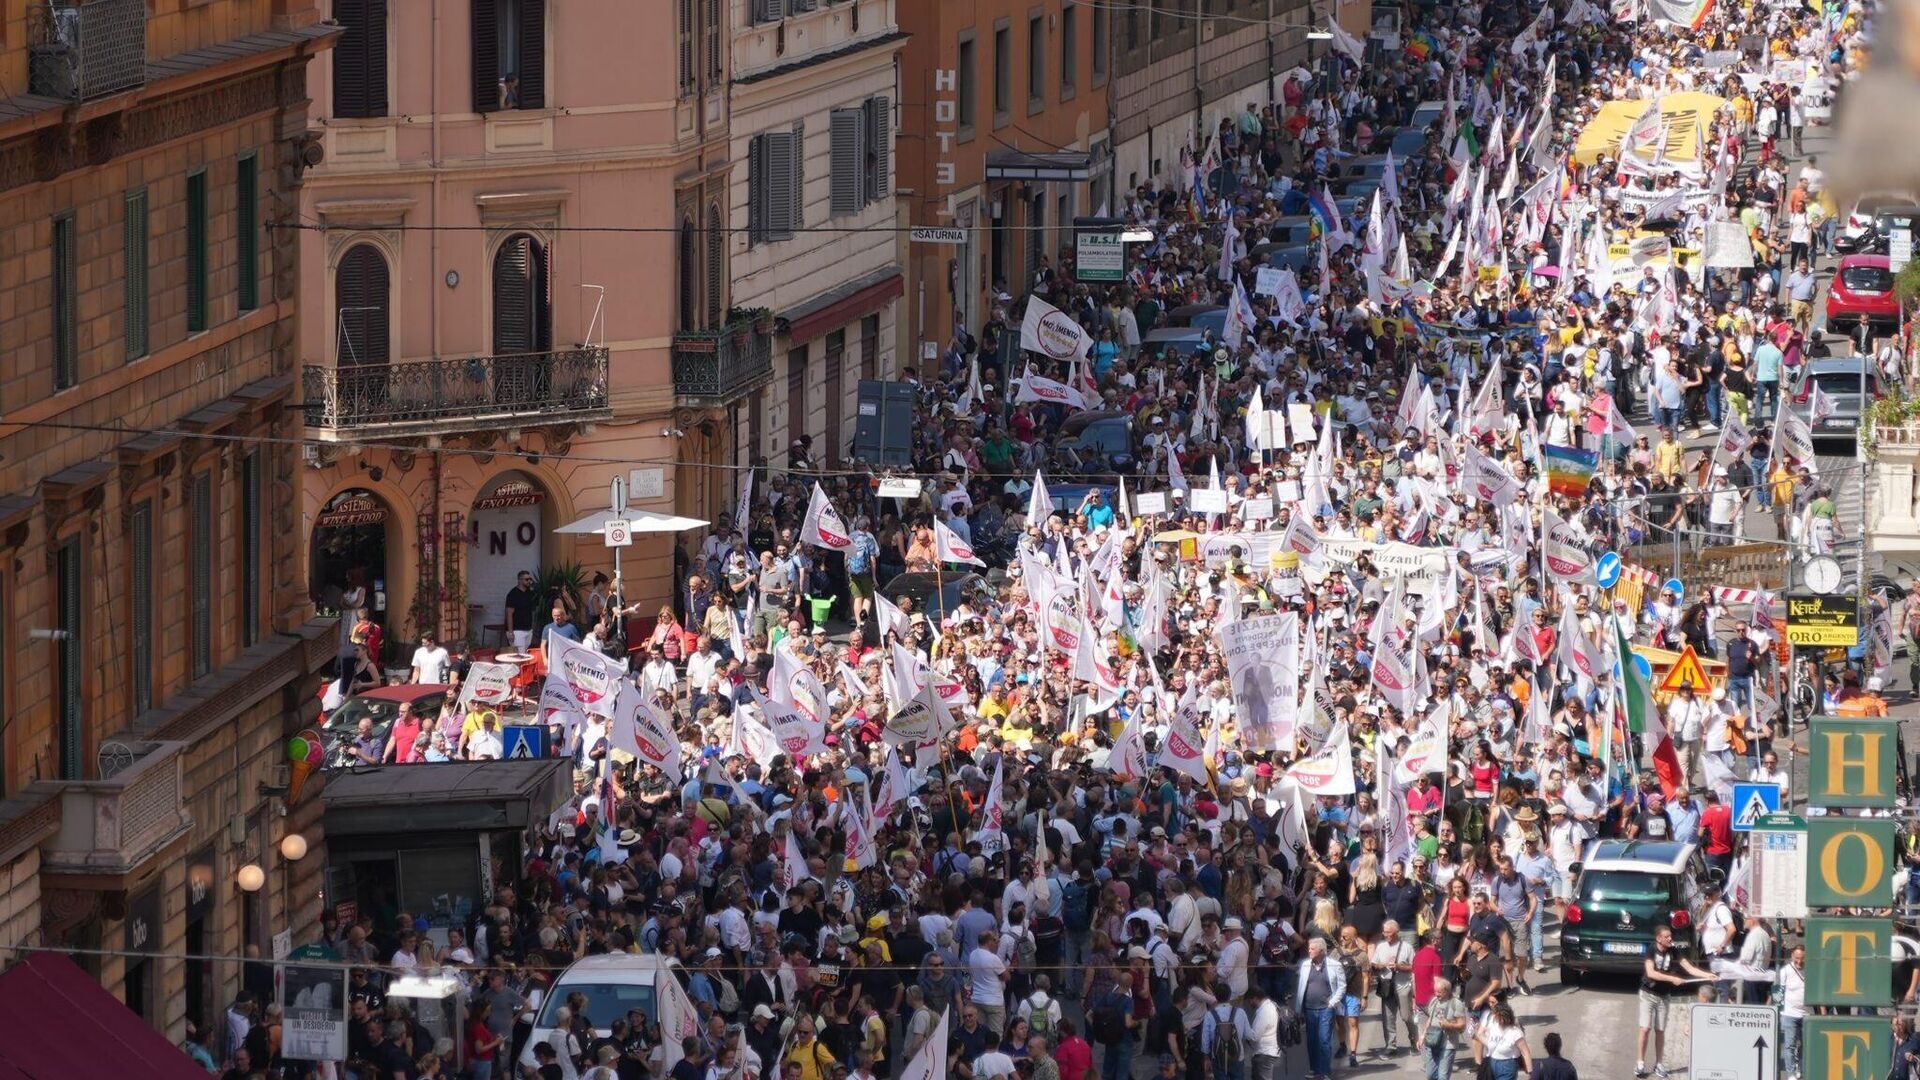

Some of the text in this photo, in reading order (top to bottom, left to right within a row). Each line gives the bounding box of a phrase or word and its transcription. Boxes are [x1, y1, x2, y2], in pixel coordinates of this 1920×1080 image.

[918, 229, 963, 241] SATURNIA
[1043, 319, 1079, 340] MOVIMENTO
[496, 483, 529, 496] ASTEMIO
[337, 499, 372, 513] ASTEMIO
[480, 496, 536, 508] ENOTECA
[323, 514, 347, 525] WINE
[357, 511, 382, 523] FOOD
[1554, 560, 1574, 573] 2050
[1790, 600, 1821, 615] KETER
[1836, 615, 1846, 624] 7
[1789, 631, 1822, 643] ORO
[564, 660, 606, 681] MOVIMENTO
[1374, 665, 1395, 685] 2050
[1170, 738, 1189, 756] 2050
[1730, 1011, 1771, 1019] stazione
[292, 1020, 337, 1031] UN DESIDERIO
[1728, 1019, 1771, 1029] Termini
